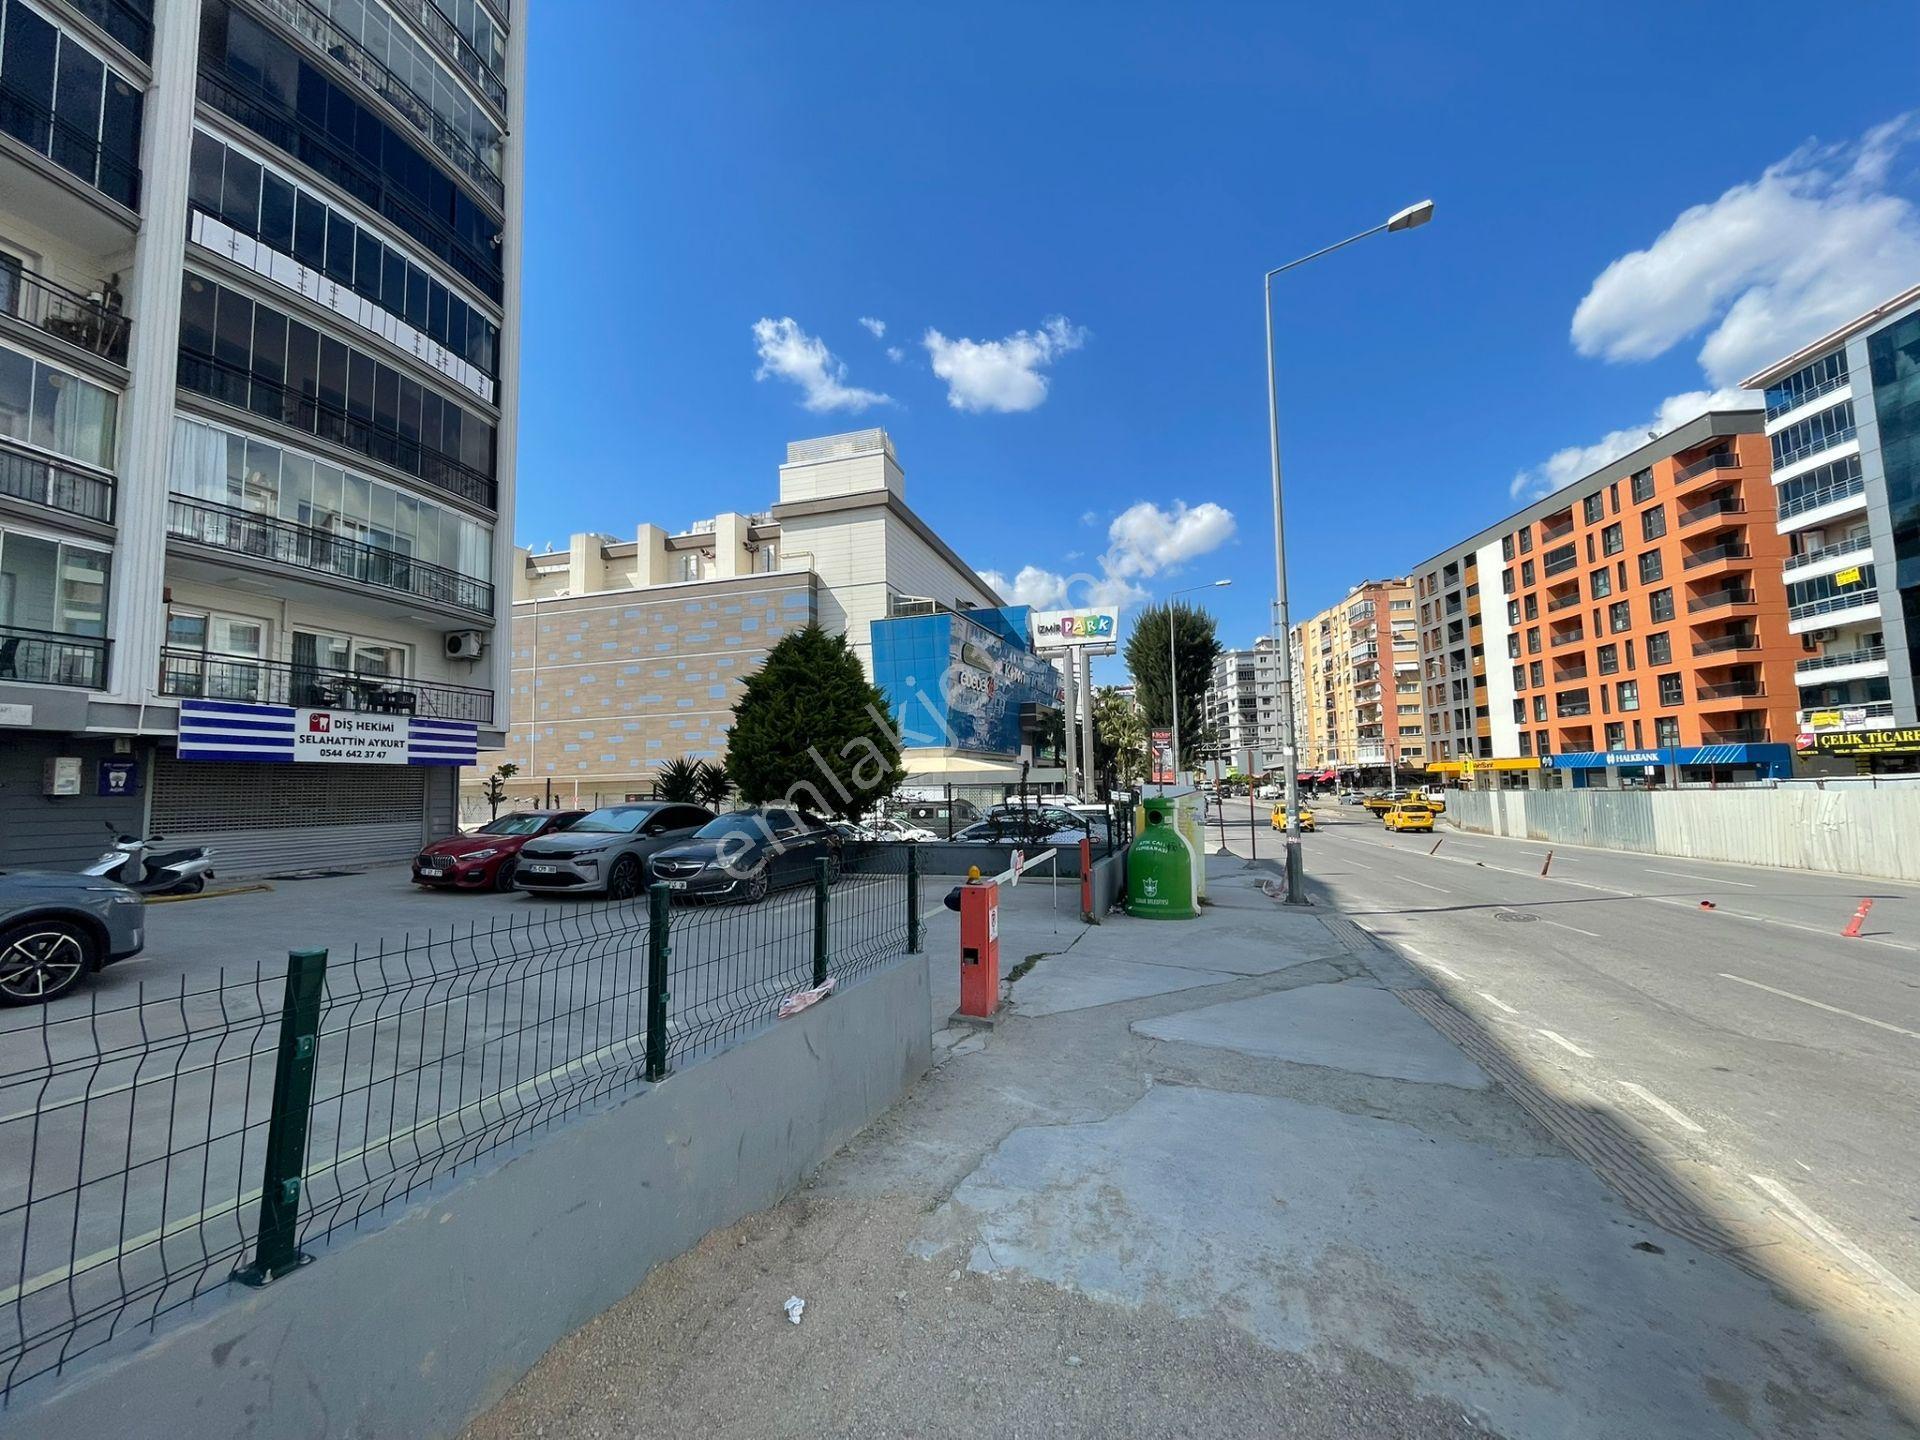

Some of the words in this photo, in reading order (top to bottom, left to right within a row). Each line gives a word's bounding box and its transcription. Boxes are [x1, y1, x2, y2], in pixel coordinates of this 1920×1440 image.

[1064, 617, 1110, 634] PARK
[334, 717, 353, 731] DİŞ
[356, 721, 394, 732] HEKİMİ
[299, 734, 366, 747] SELAHATTİN
[368, 739, 405, 748] AYKURT
[1821, 731, 1863, 748] ÇELİK
[320, 749, 342, 757] 0544
[346, 749, 362, 758] 642
[376, 751, 387, 759] 47
[1616, 752, 1659, 763] HALKBANK
